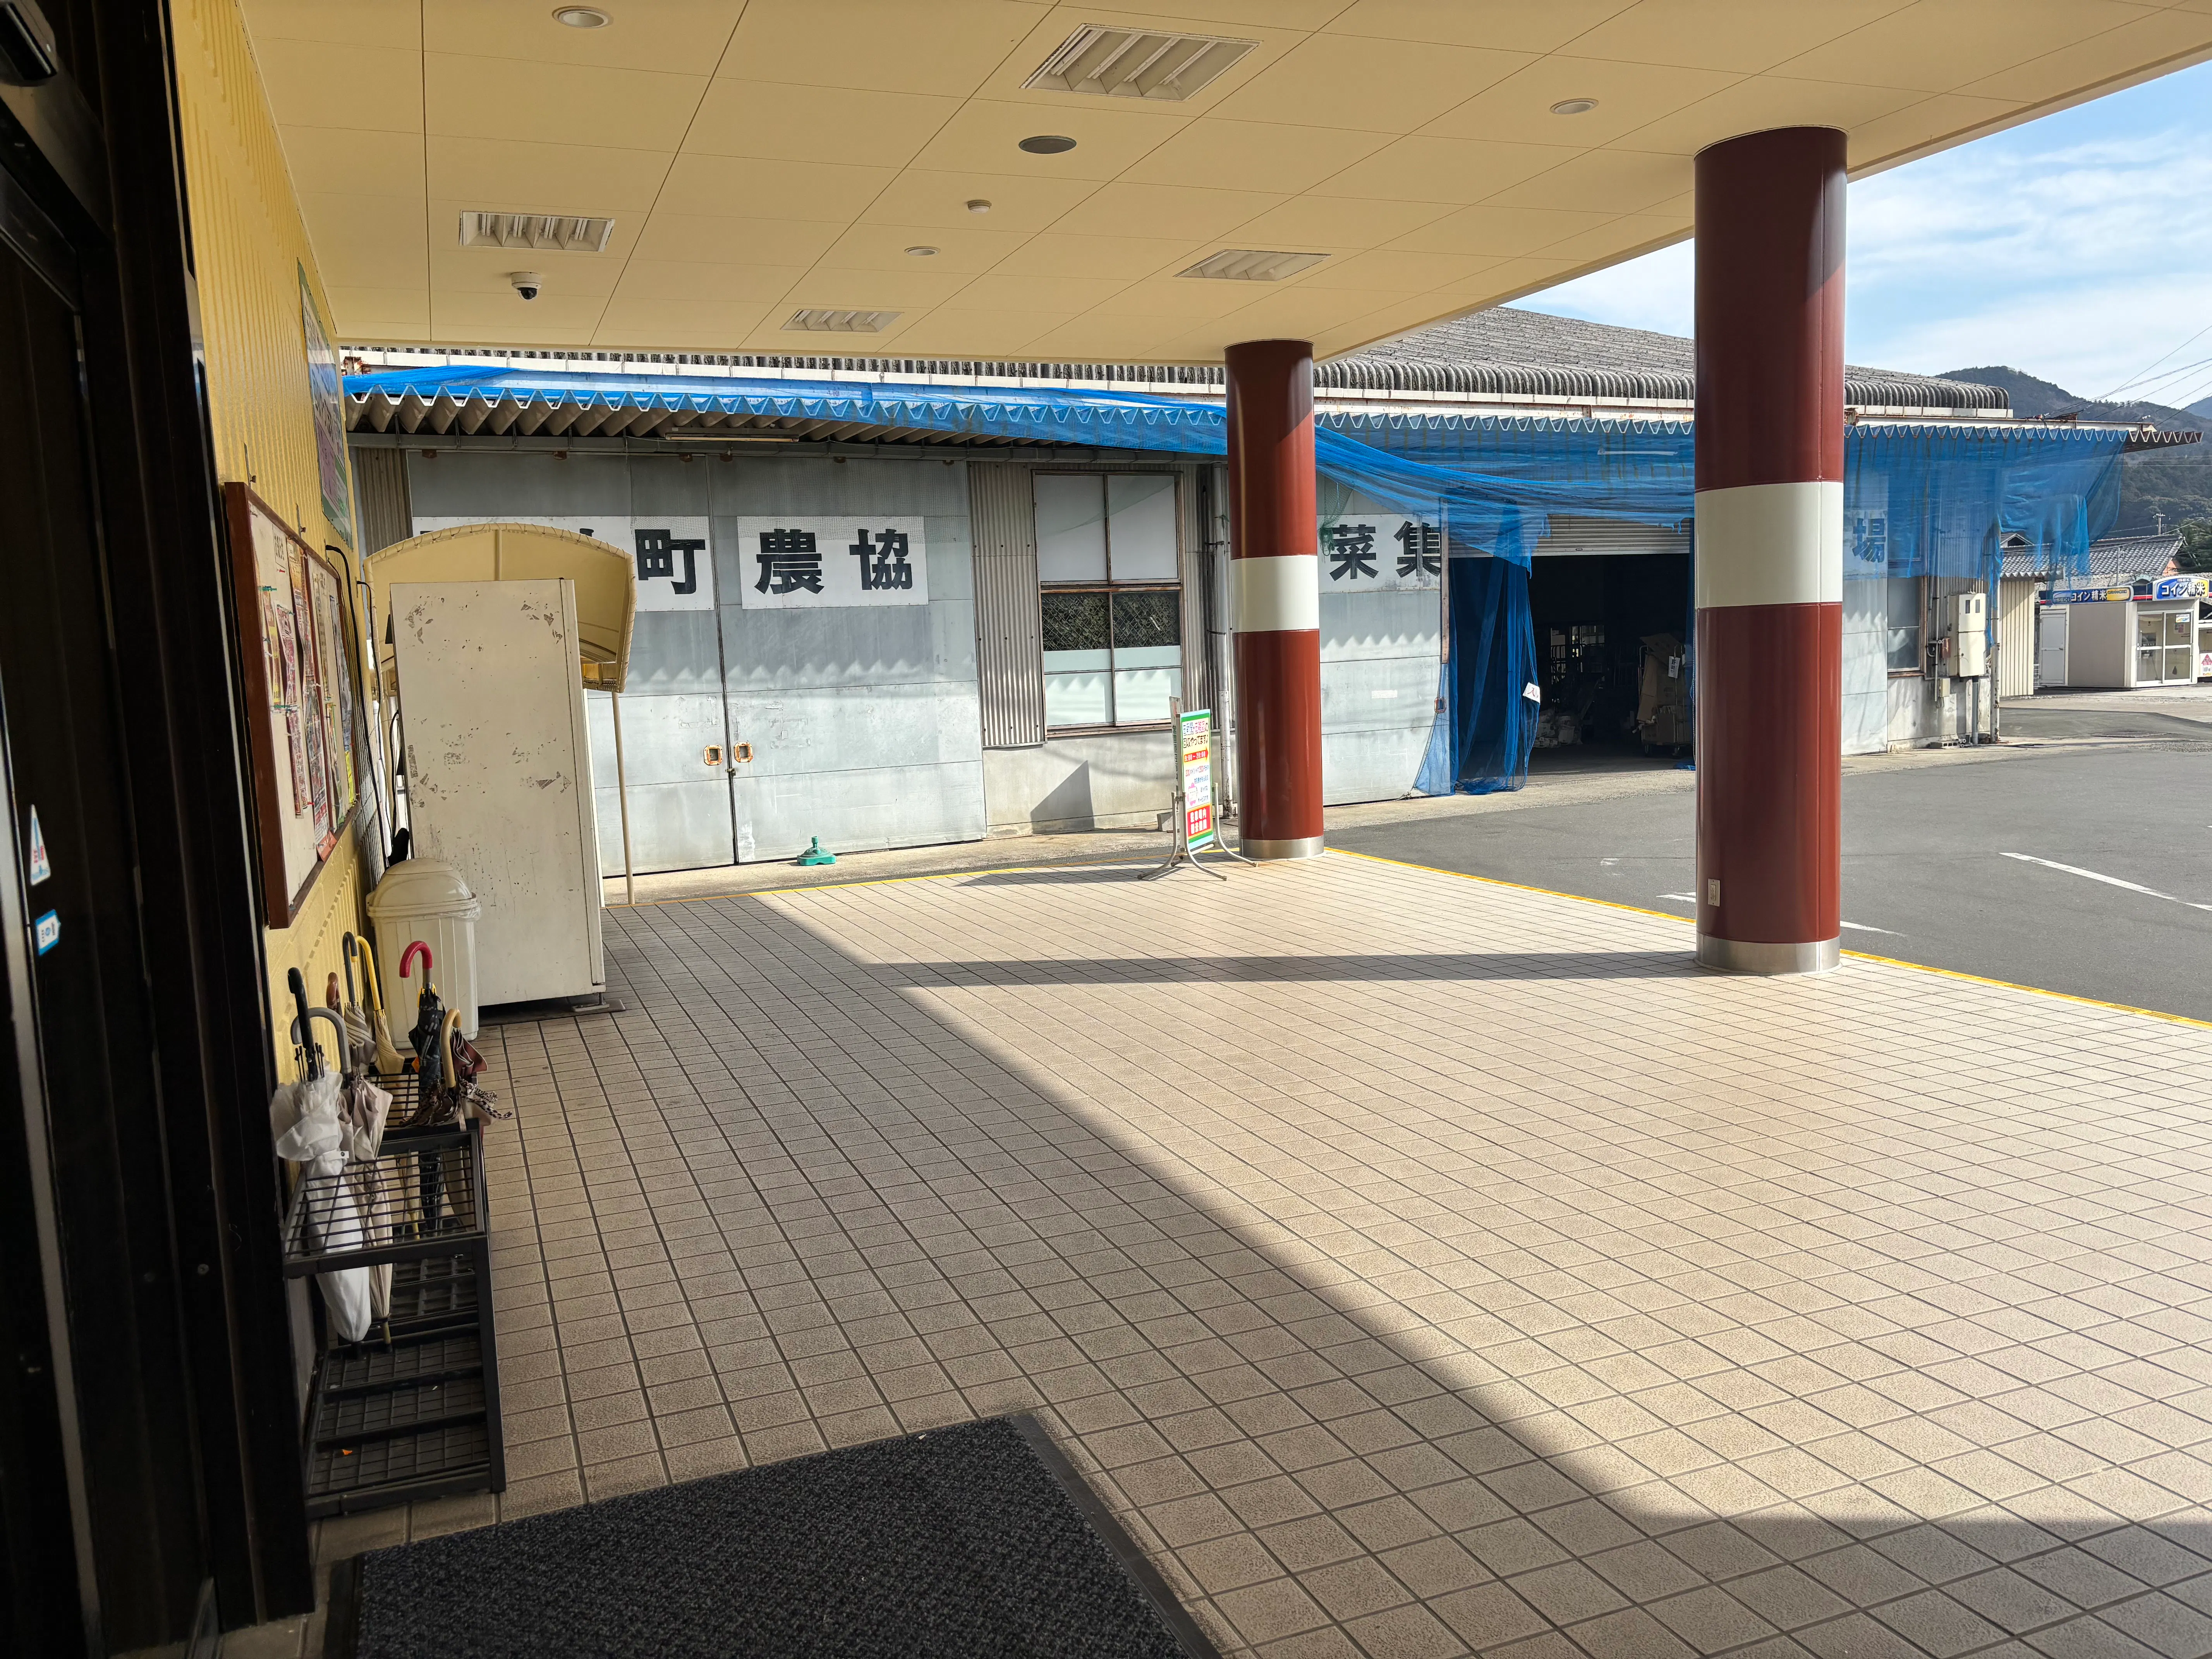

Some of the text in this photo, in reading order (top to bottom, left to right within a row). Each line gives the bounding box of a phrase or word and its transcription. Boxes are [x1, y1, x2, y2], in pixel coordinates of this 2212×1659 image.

[1852, 518, 1886, 563] 場
[755, 529, 913, 594] 農協
[2071, 590, 2107, 602] コイン精米
[2161, 582, 2205, 596] コイン精米
